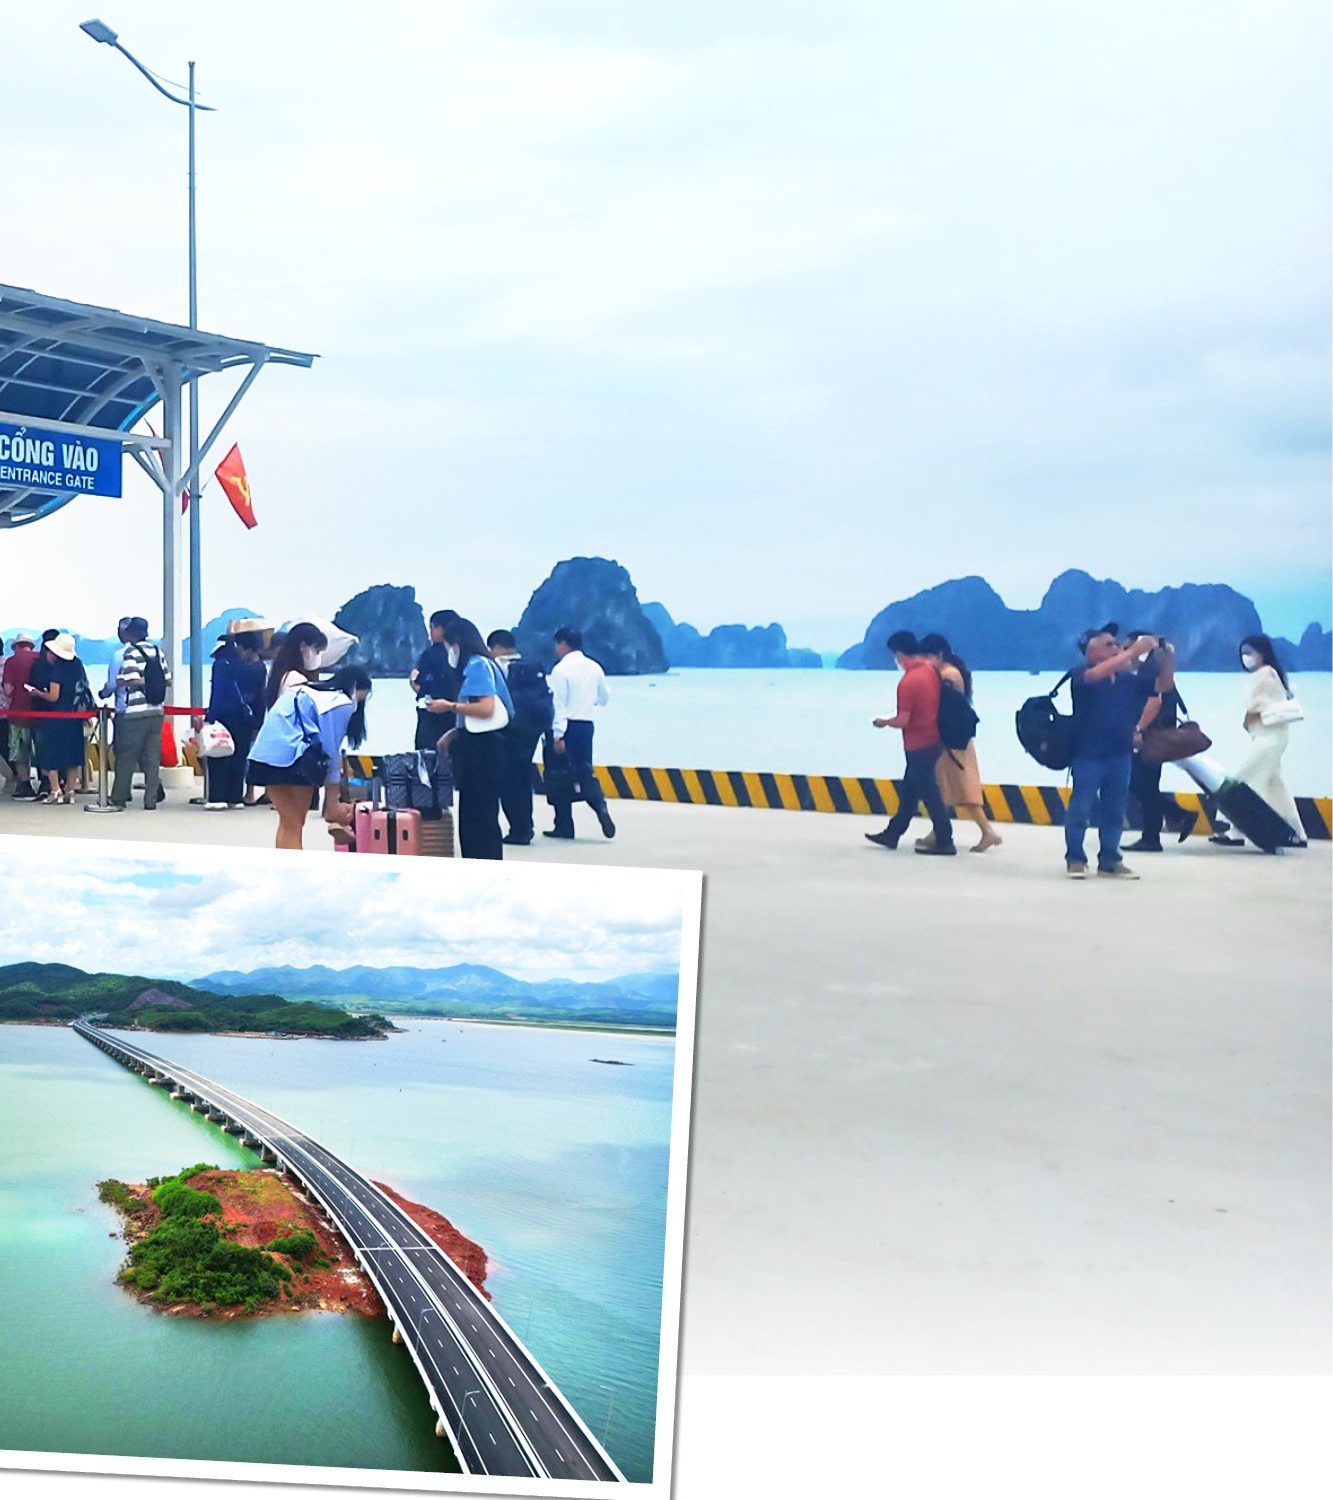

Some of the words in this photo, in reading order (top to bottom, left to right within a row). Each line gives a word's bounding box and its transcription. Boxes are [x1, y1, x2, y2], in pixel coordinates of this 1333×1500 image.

[62, 440, 99, 472] VÀO
[0, 465, 62, 486] ENTRANCE
[66, 475, 95, 490] GATE
